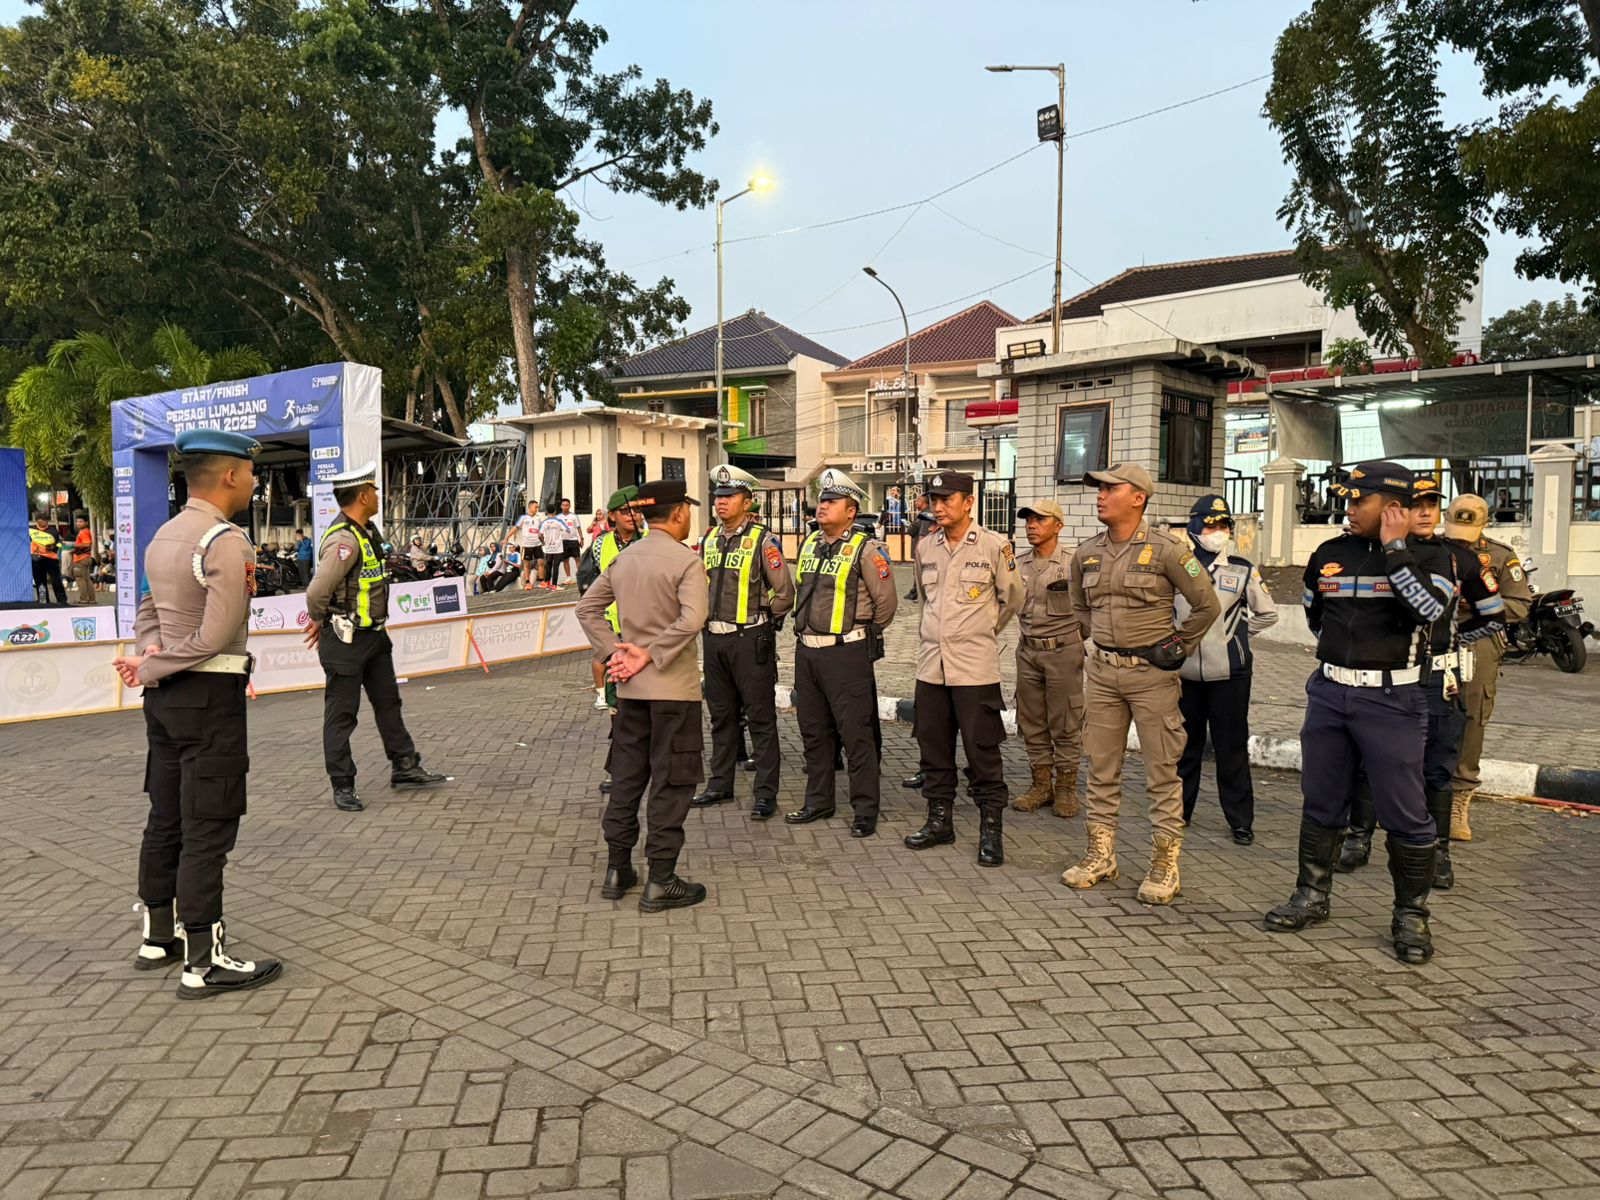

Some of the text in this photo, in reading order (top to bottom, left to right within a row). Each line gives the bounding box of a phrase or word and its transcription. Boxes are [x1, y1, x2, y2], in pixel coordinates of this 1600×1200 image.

[182, 383, 249, 404] START/FINISH
[166, 408, 206, 424] PERSAGI
[208, 399, 267, 418] LUMAJANG
[224, 415, 257, 432] 2025
[414, 593, 430, 607] gigi
[1389, 566, 1445, 622] DISHUB
